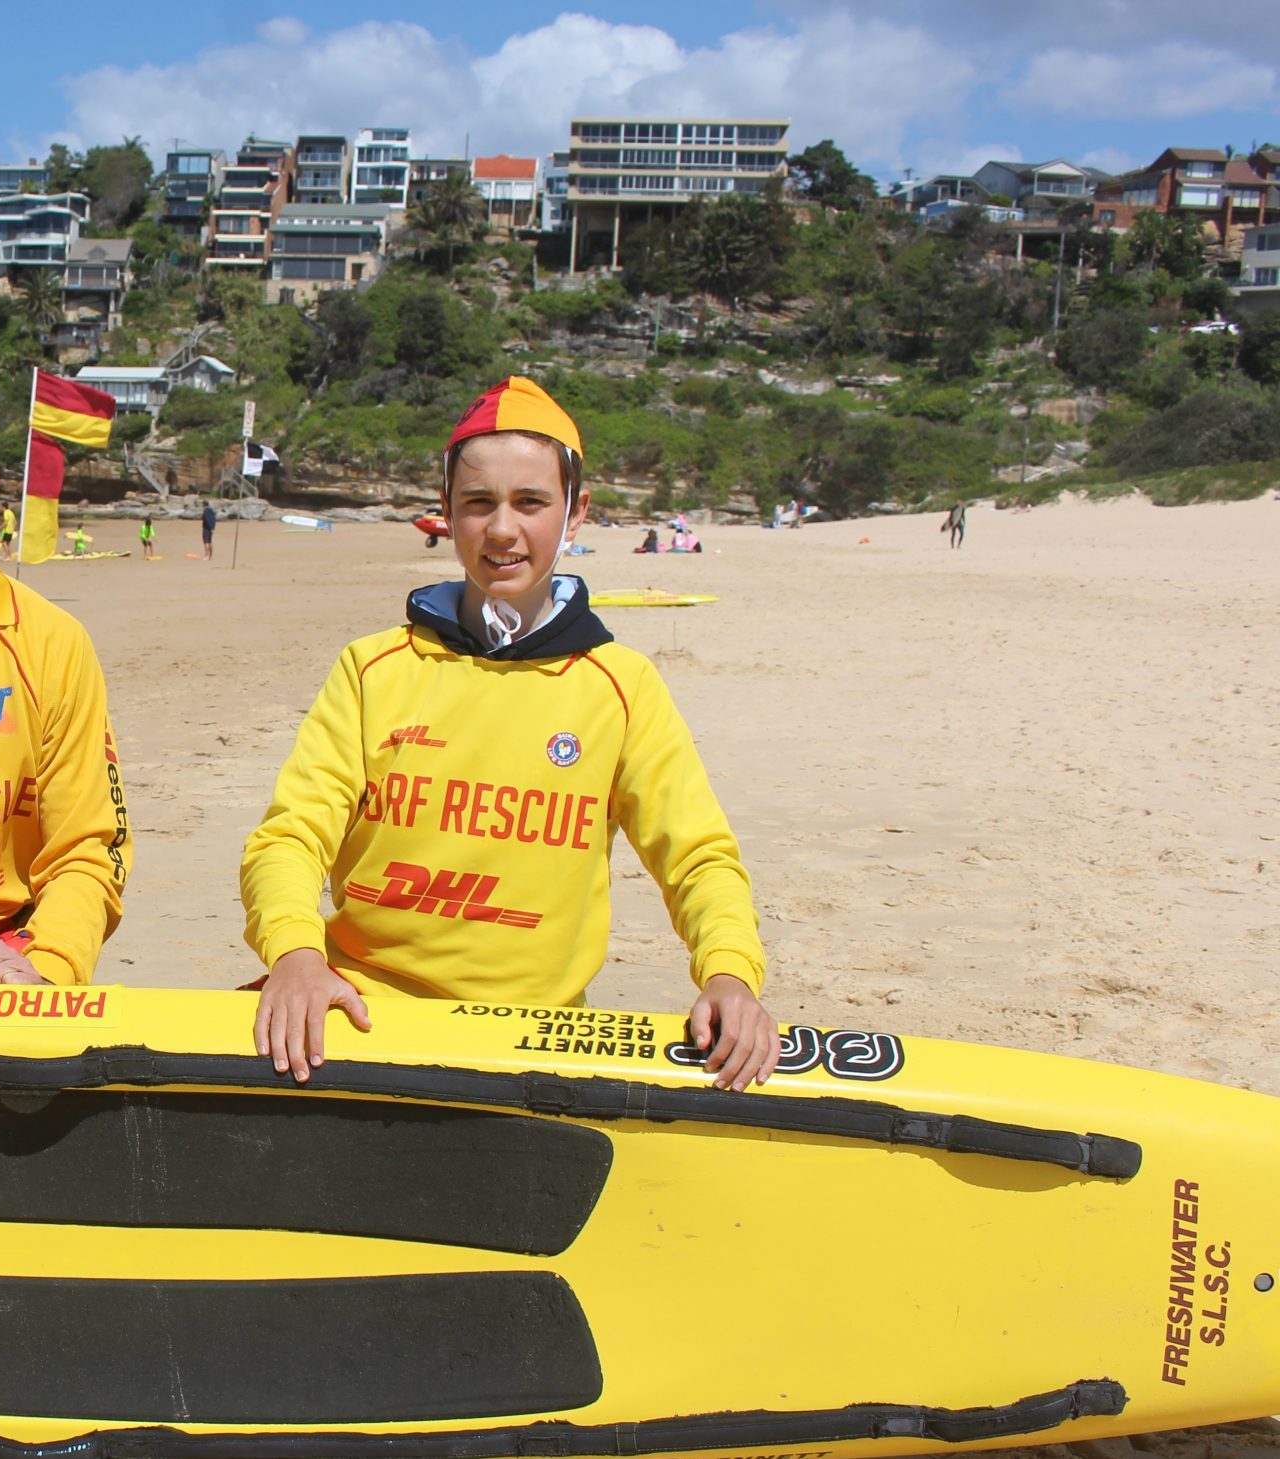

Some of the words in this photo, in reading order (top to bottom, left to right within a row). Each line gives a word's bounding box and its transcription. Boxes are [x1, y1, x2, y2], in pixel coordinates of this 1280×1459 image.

[388, 724, 432, 746] DHL
[439, 779, 599, 850] RESCUE
[375, 861, 504, 922] DHL
[450, 1004, 654, 1027] TECHNOLOGY
[537, 1021, 655, 1042] RESCUE
[514, 1036, 656, 1059] BENNETT
[1161, 1178, 1200, 1386] FRESHWATER
[1199, 1240, 1231, 1348] S.L.S.C.
